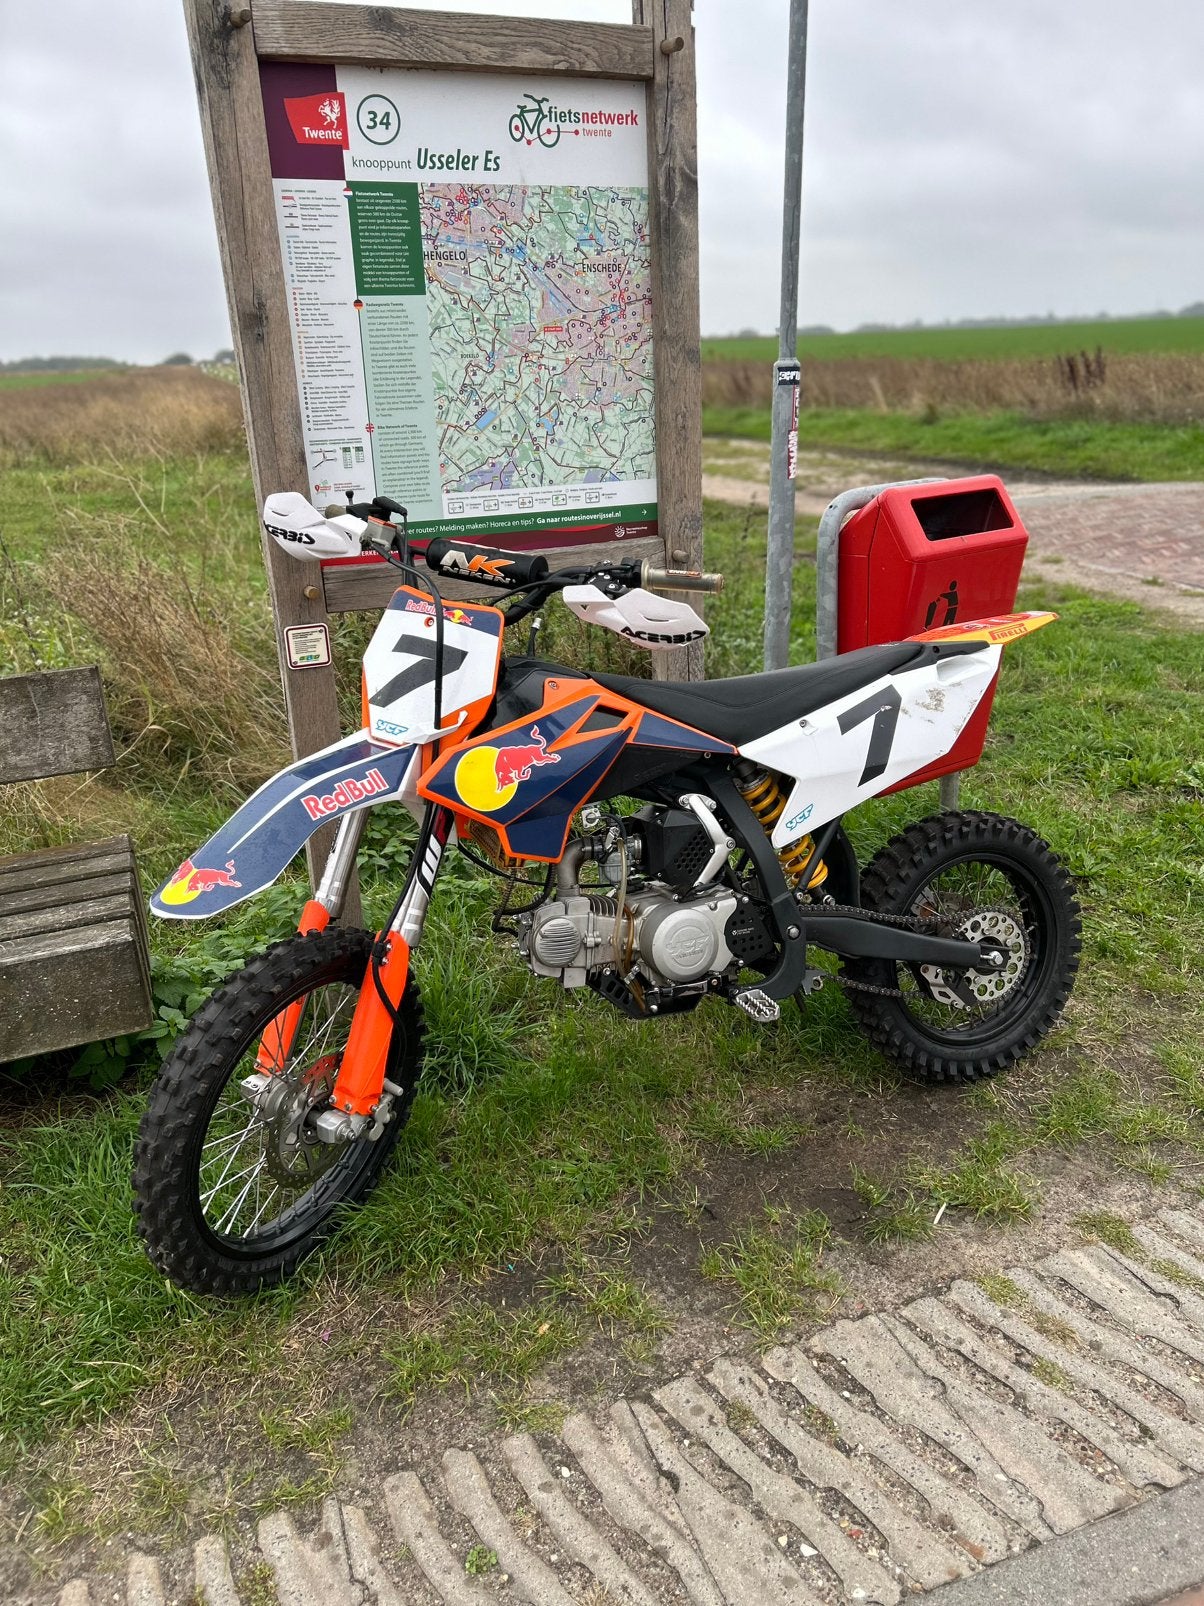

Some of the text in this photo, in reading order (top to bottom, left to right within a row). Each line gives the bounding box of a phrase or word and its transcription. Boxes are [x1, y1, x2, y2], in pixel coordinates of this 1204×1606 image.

[366, 110, 392, 131] 34
[547, 106, 639, 126] fietsnetwerk
[302, 126, 343, 140] Twente
[582, 127, 612, 138] twente
[351, 147, 501, 172] knooppunt Usseler Es
[423, 250, 466, 261] HENGELO
[581, 263, 622, 273] ENSCHEDE
[415, 526, 439, 534] routes?
[439, 524, 465, 533] Melding
[465, 521, 489, 530] maken?
[490, 520, 511, 528] Horeca
[520, 518, 534, 527] tips?
[561, 510, 622, 523] routesinoverijssel.nl
[620, 626, 707, 644] ACERBIS
[988, 622, 1028, 641] PIRELLI
[368, 633, 469, 709] 7
[836, 683, 903, 788] 7
